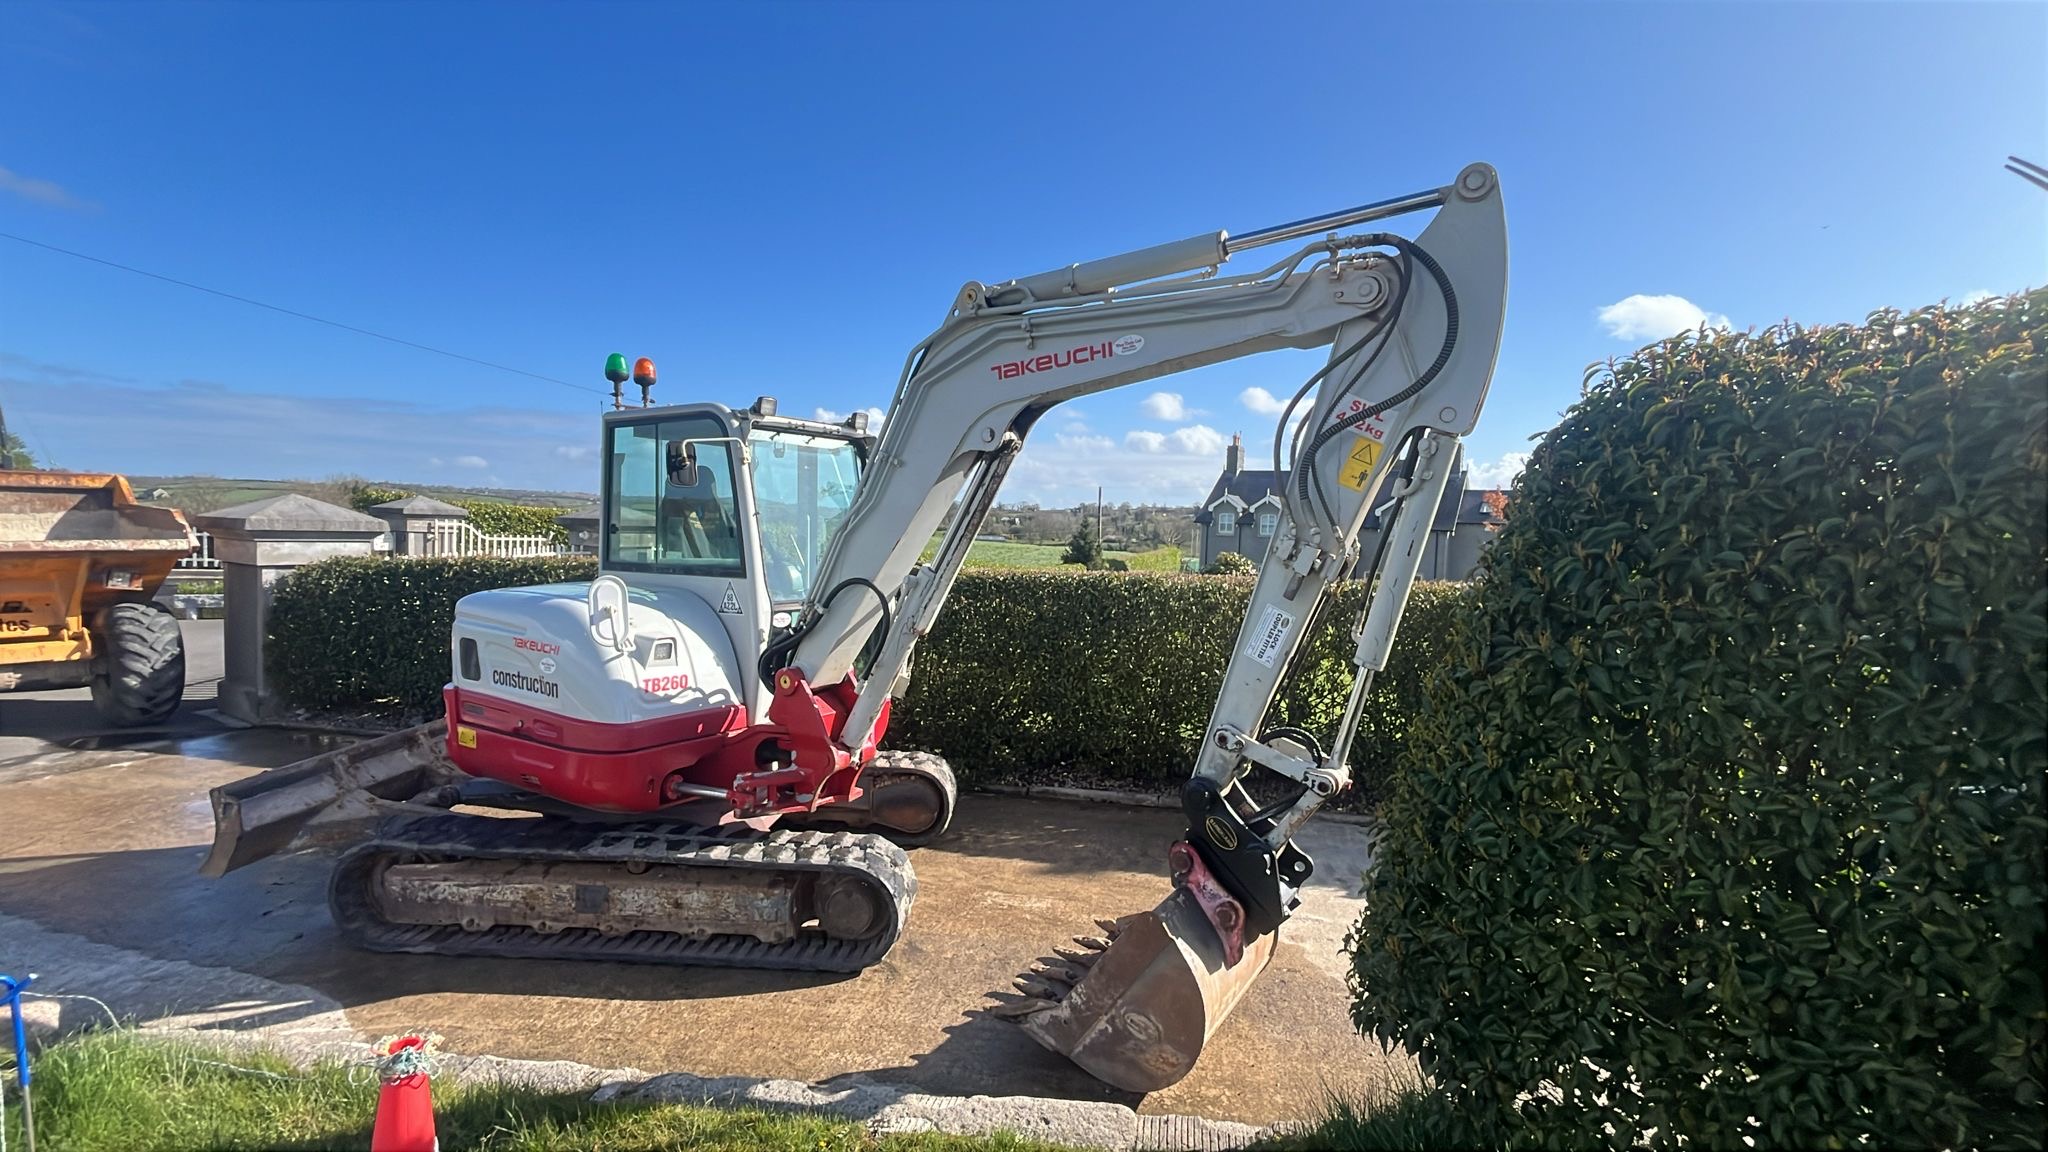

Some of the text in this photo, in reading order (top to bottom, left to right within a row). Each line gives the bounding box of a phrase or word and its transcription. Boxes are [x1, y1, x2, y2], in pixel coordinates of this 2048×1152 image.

[991, 341, 1113, 380] TAKEUCHI
[1350, 400, 1384, 422] SL
[1336, 411, 1384, 440] 42kg
[1268, 613, 1283, 639] COUPLER
[513, 637, 560, 657] TAKEUCHI
[1257, 638, 1271, 659] FITTED
[493, 669, 559, 699] construction
[643, 674, 689, 694] TB260
